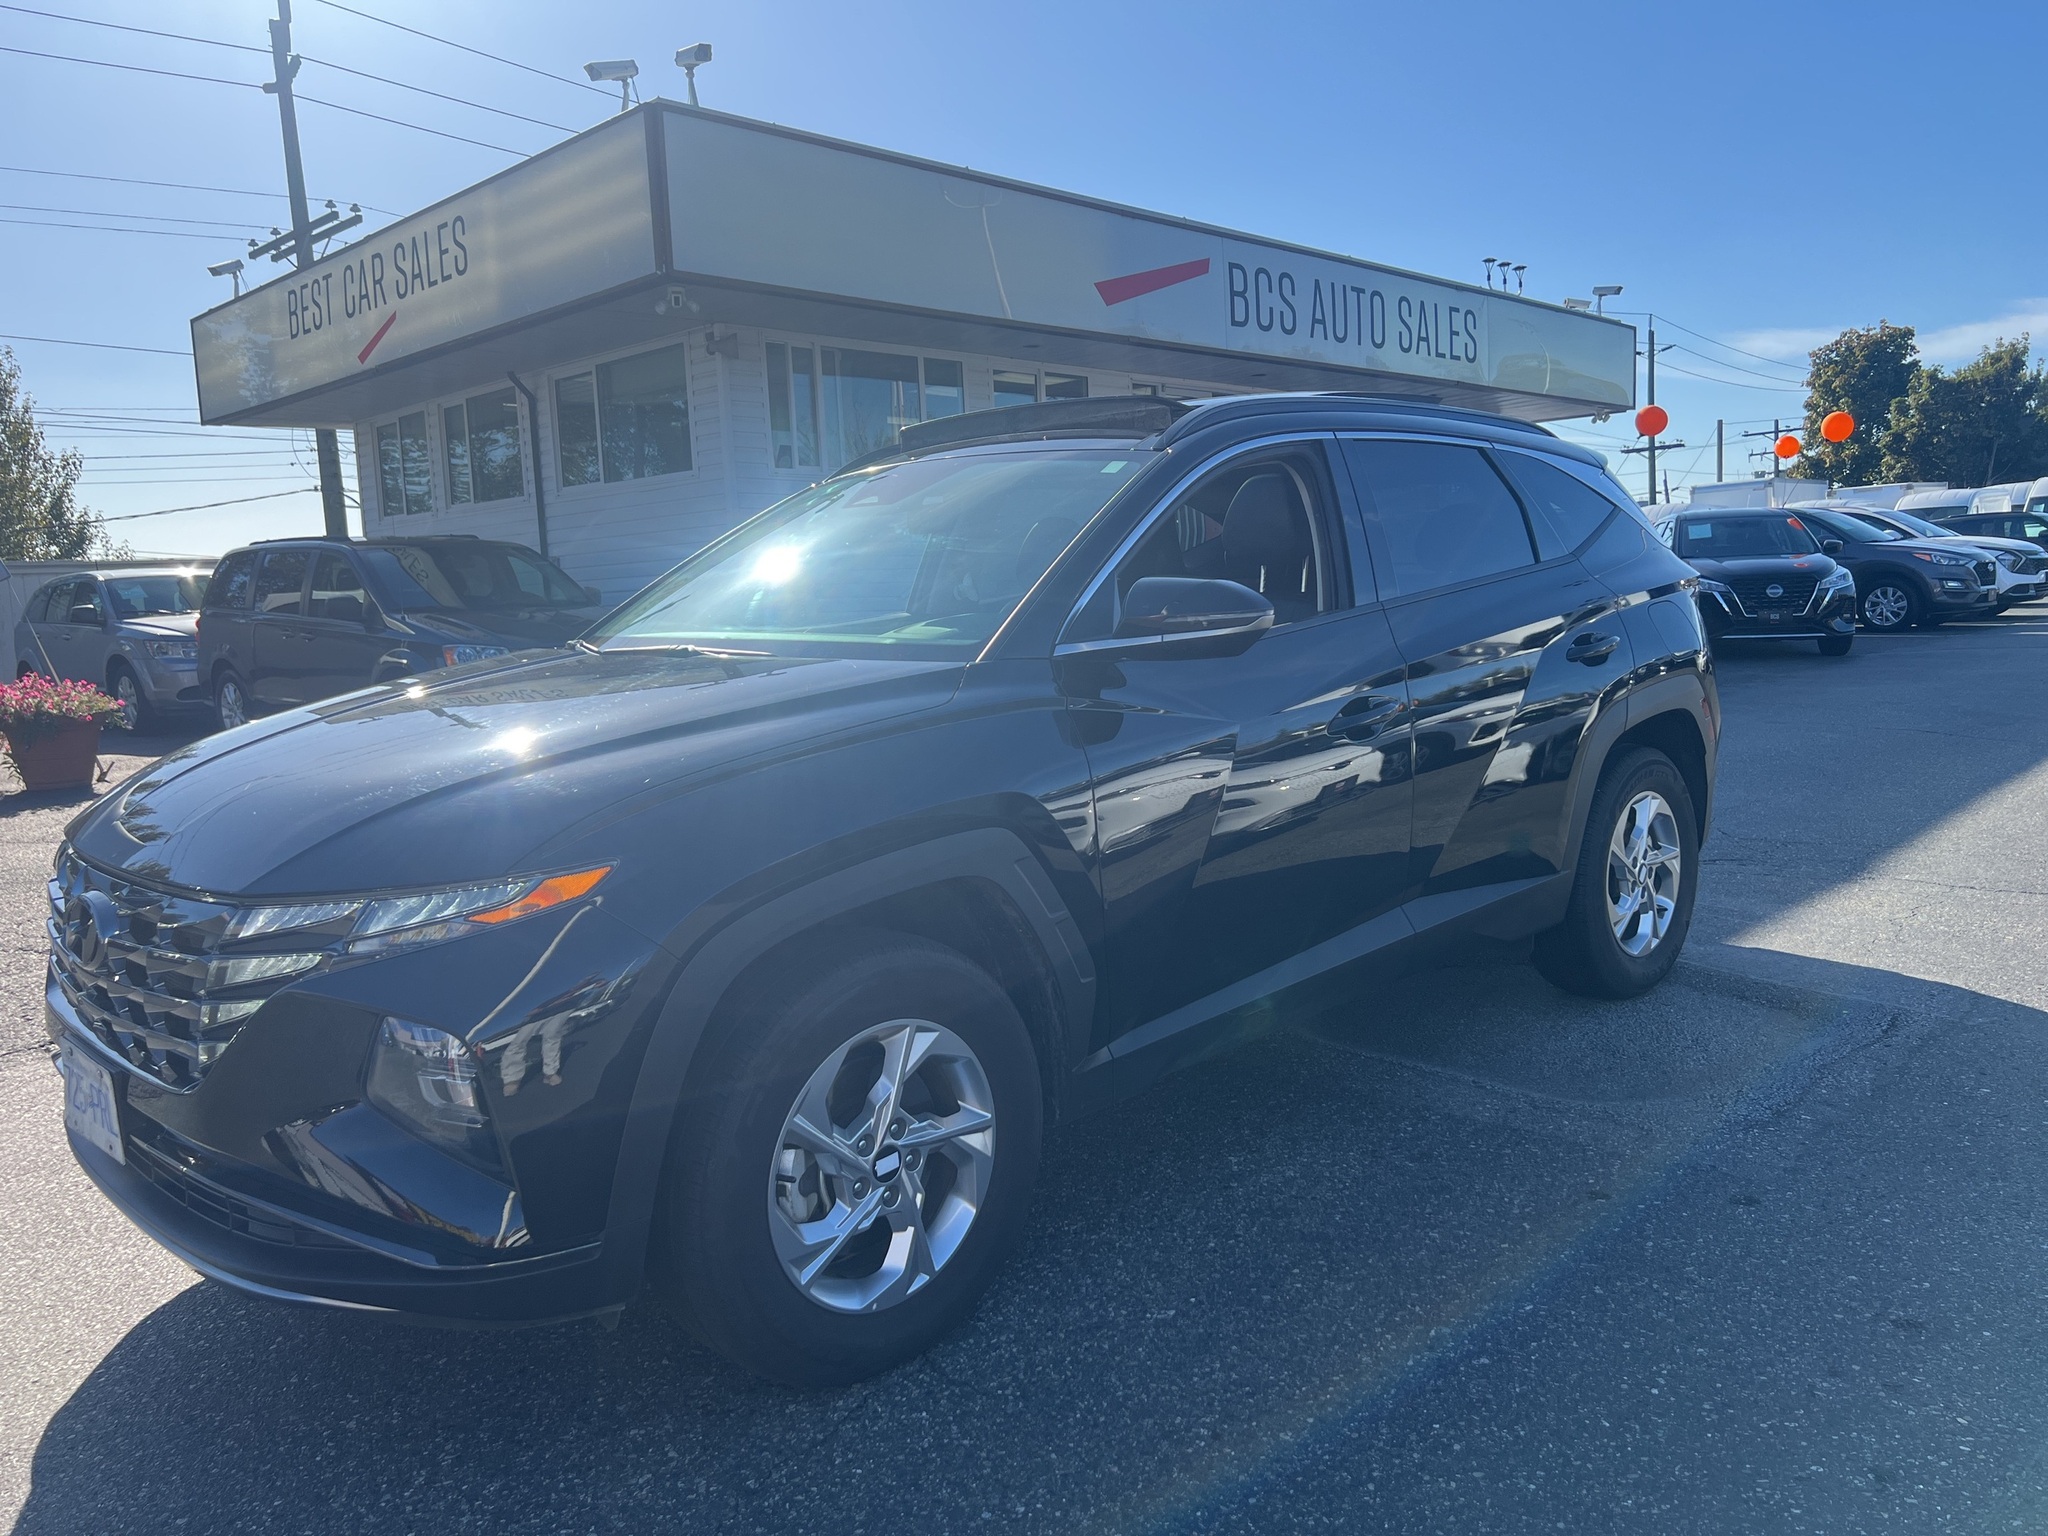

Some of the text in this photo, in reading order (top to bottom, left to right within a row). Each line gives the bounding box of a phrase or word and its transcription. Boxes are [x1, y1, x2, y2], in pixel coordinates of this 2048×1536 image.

[287, 215, 468, 340] BEST CAR SALES
[1227, 261, 1478, 364] BCS AUTO SALES
